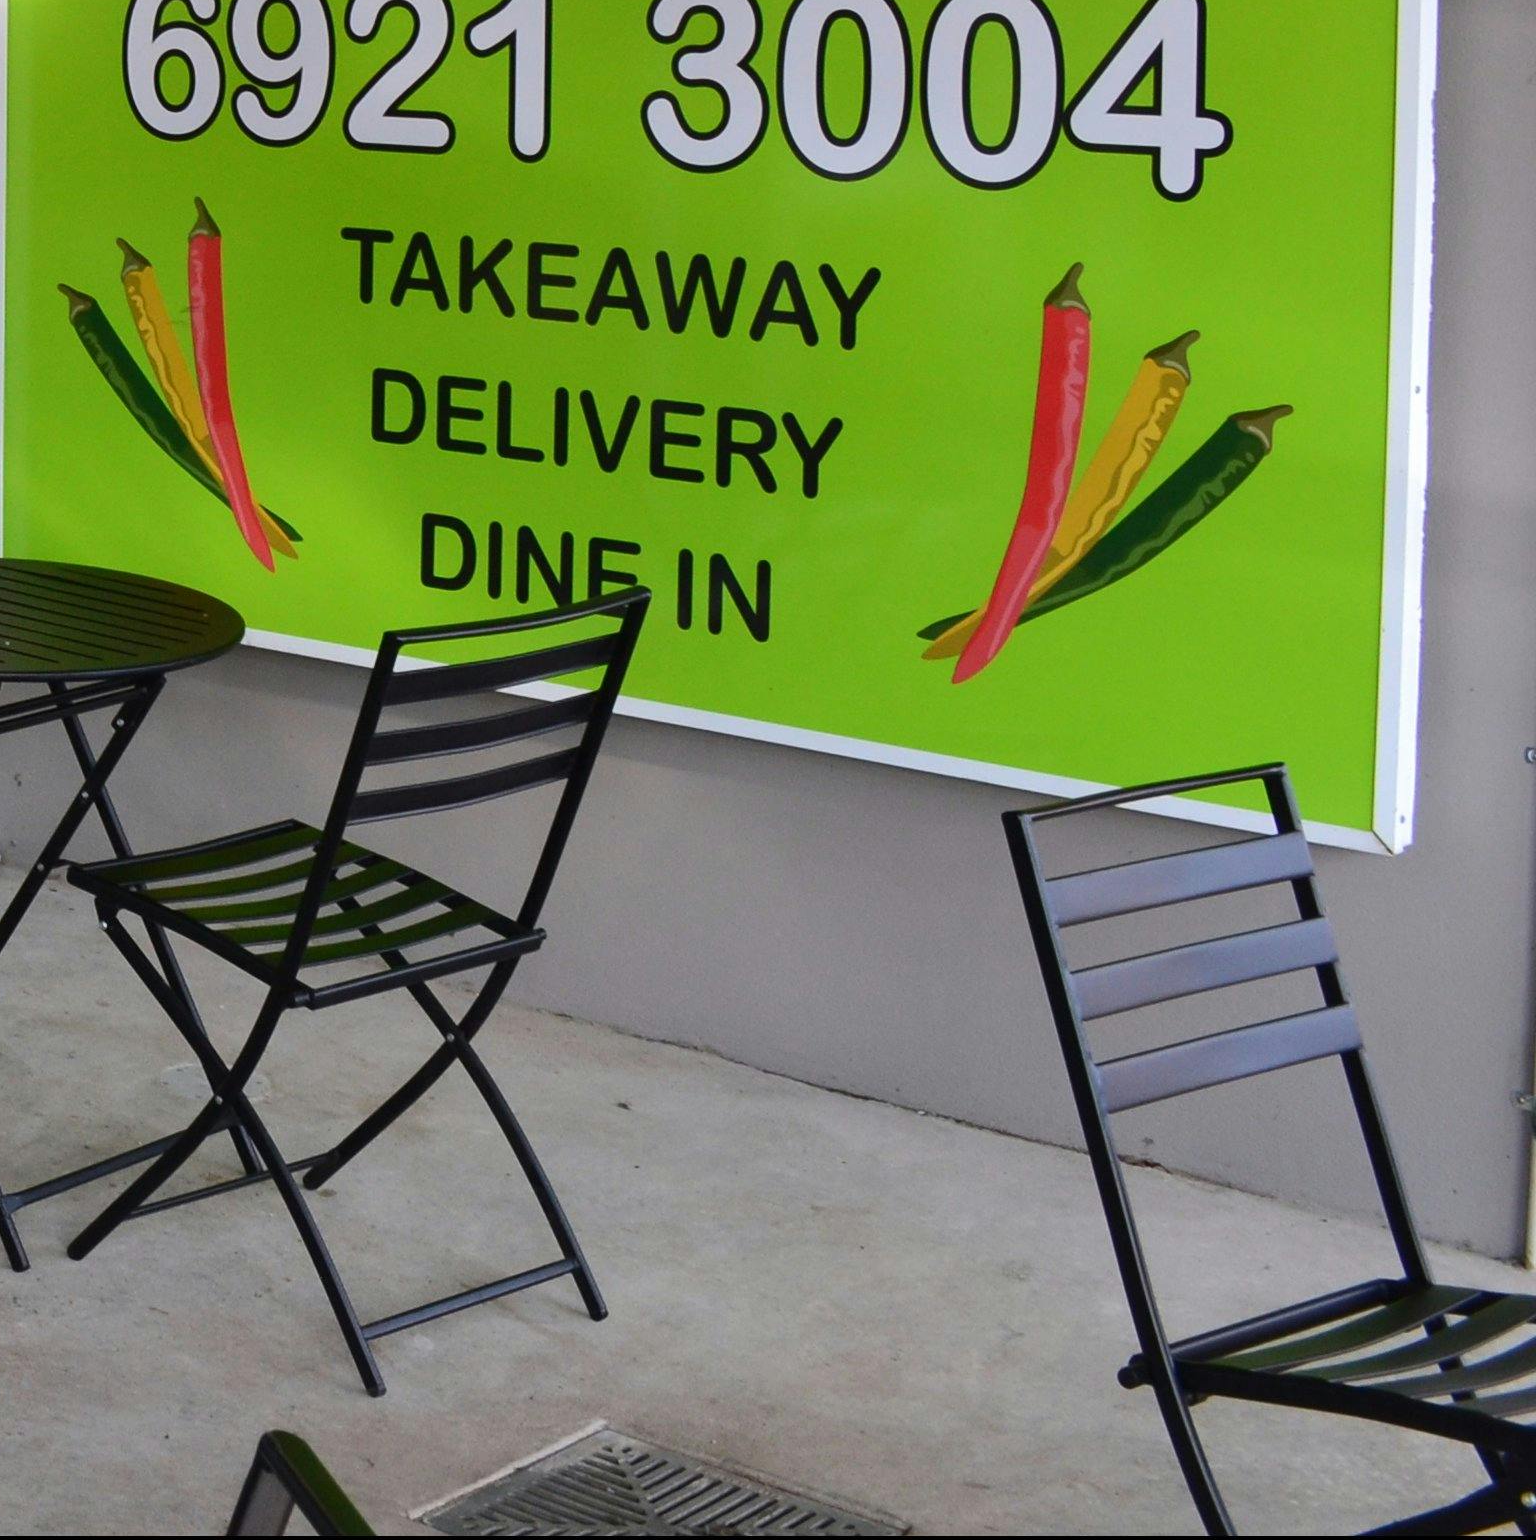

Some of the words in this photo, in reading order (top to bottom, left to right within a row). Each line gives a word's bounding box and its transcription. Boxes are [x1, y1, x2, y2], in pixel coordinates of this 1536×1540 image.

[340, 226, 883, 352] TAKEAWAY
[369, 367, 845, 500] DELIVERY
[675, 547, 772, 644] IN
